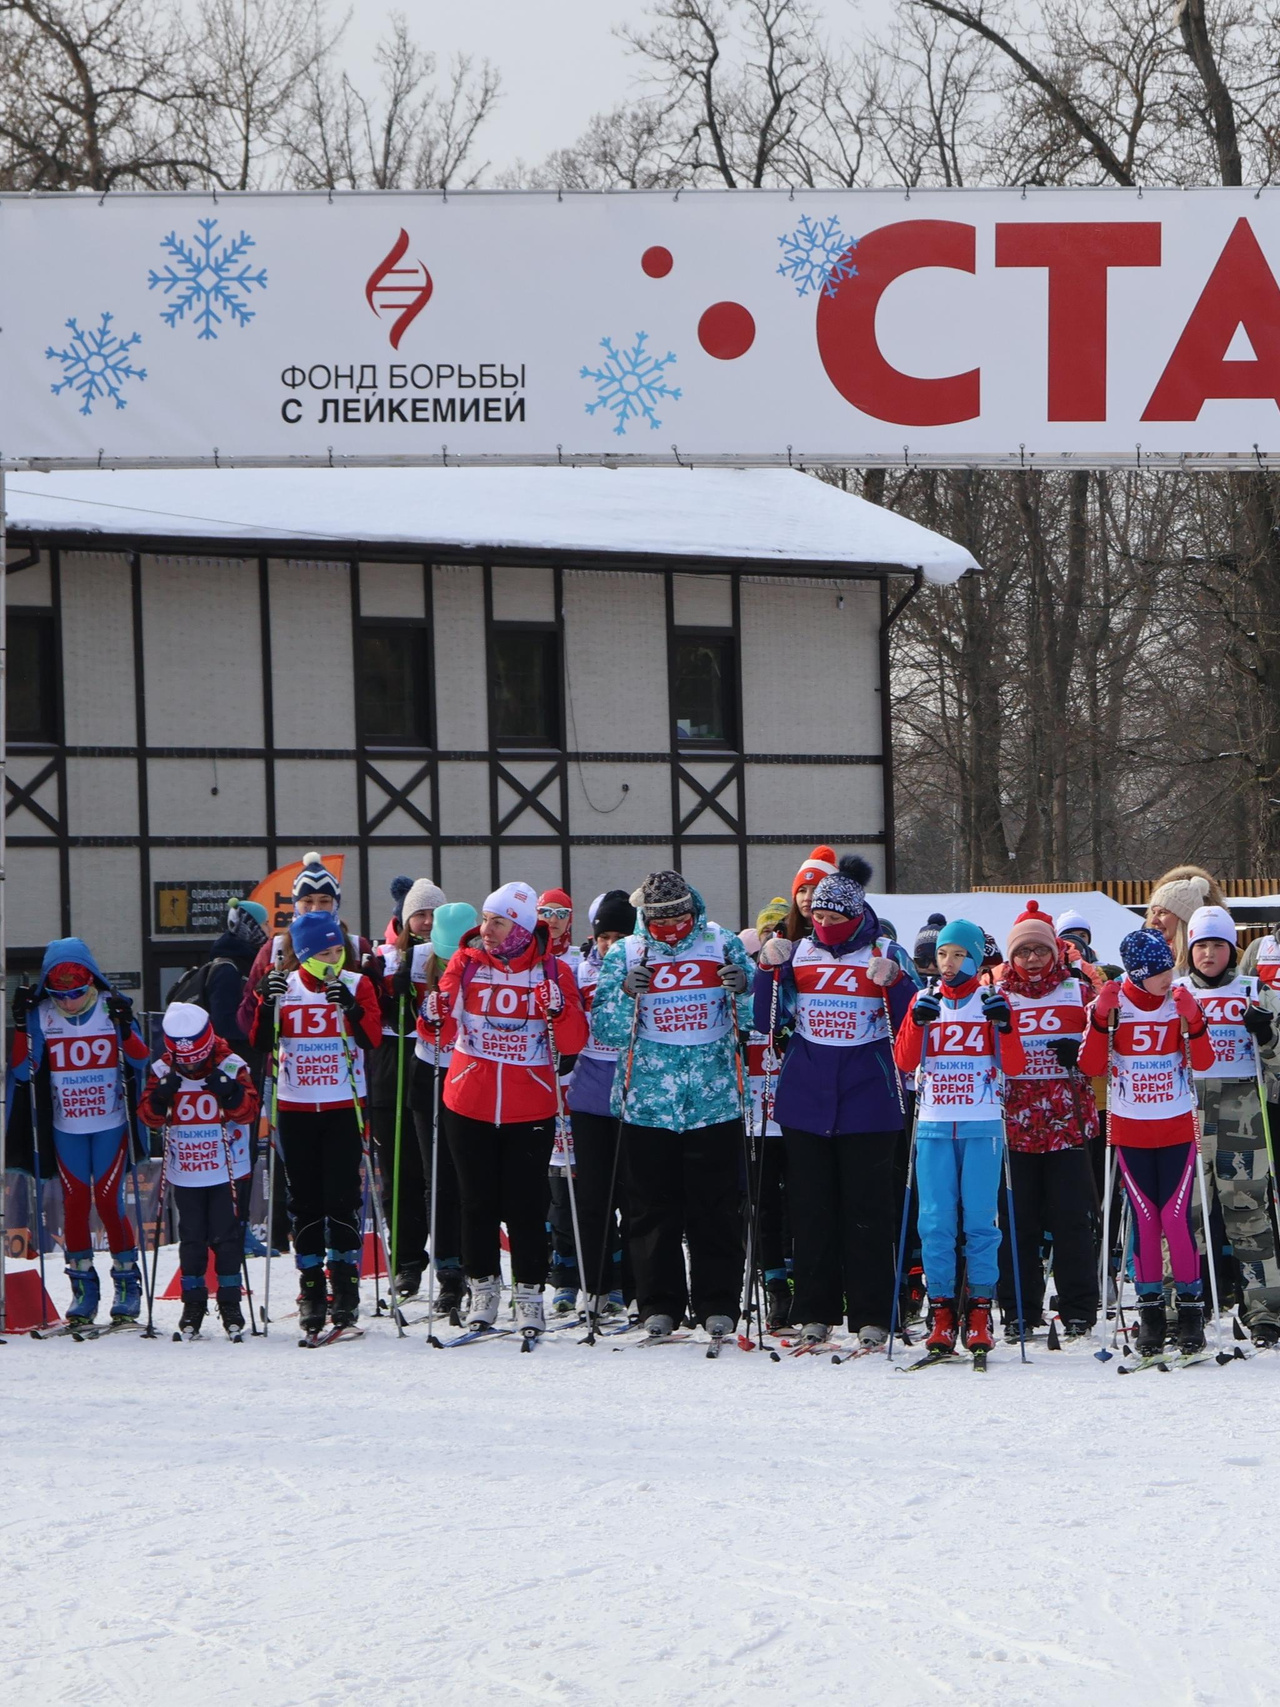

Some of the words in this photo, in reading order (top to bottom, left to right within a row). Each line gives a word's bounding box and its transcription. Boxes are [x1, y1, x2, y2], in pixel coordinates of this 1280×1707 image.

[281, 364, 377, 395] ФОНД
[389, 363, 527, 391] БОРЬБЫ
[281, 398, 303, 425] С
[317, 392, 527, 425] ЛЕЙКЕМИЕЙ
[653, 962, 703, 989] 62
[814, 967, 859, 992] 74
[477, 988, 536, 1016] 101
[653, 1003, 708, 1016] САМОЕ
[808, 1010, 857, 1020] САМОЕ
[288, 1008, 345, 1034] 131
[653, 1013, 708, 1025] ВРЕМЯ
[808, 1019, 857, 1030] ВРЕМЯ
[1018, 1009, 1062, 1033] 56
[655, 1022, 708, 1033] ЖИТЬ
[482, 1033, 528, 1043] САМОЕ
[810, 1028, 856, 1040] ЖИТЬ
[929, 1024, 985, 1053] 124
[1131, 1025, 1168, 1051] 57
[482, 1042, 528, 1052] ВРЕМЯ
[50, 1038, 112, 1068] 109
[296, 1055, 339, 1064] САМОЕ
[296, 1065, 339, 1074] ВРЕМЯ
[297, 1075, 339, 1086] ЖИТЬ
[932, 1073, 974, 1082] САМОЕ
[1131, 1071, 1173, 1082] САМОЕ
[62, 1086, 106, 1097] САМОЕ
[932, 1083, 974, 1093] ВРЕМЯ
[1132, 1081, 1174, 1093] ВРЕМЯ
[62, 1096, 106, 1108] ВРЕМЯ
[932, 1094, 974, 1105] ЖИТЬ
[1133, 1092, 1175, 1104] ЖИТЬ
[63, 1107, 107, 1118] ЖИТЬ
[176, 1094, 218, 1121] 60
[178, 1141, 219, 1150] САМОЕ
[178, 1150, 218, 1160] ВРЕМЯ
[179, 1160, 220, 1171] ЖИТЬ
